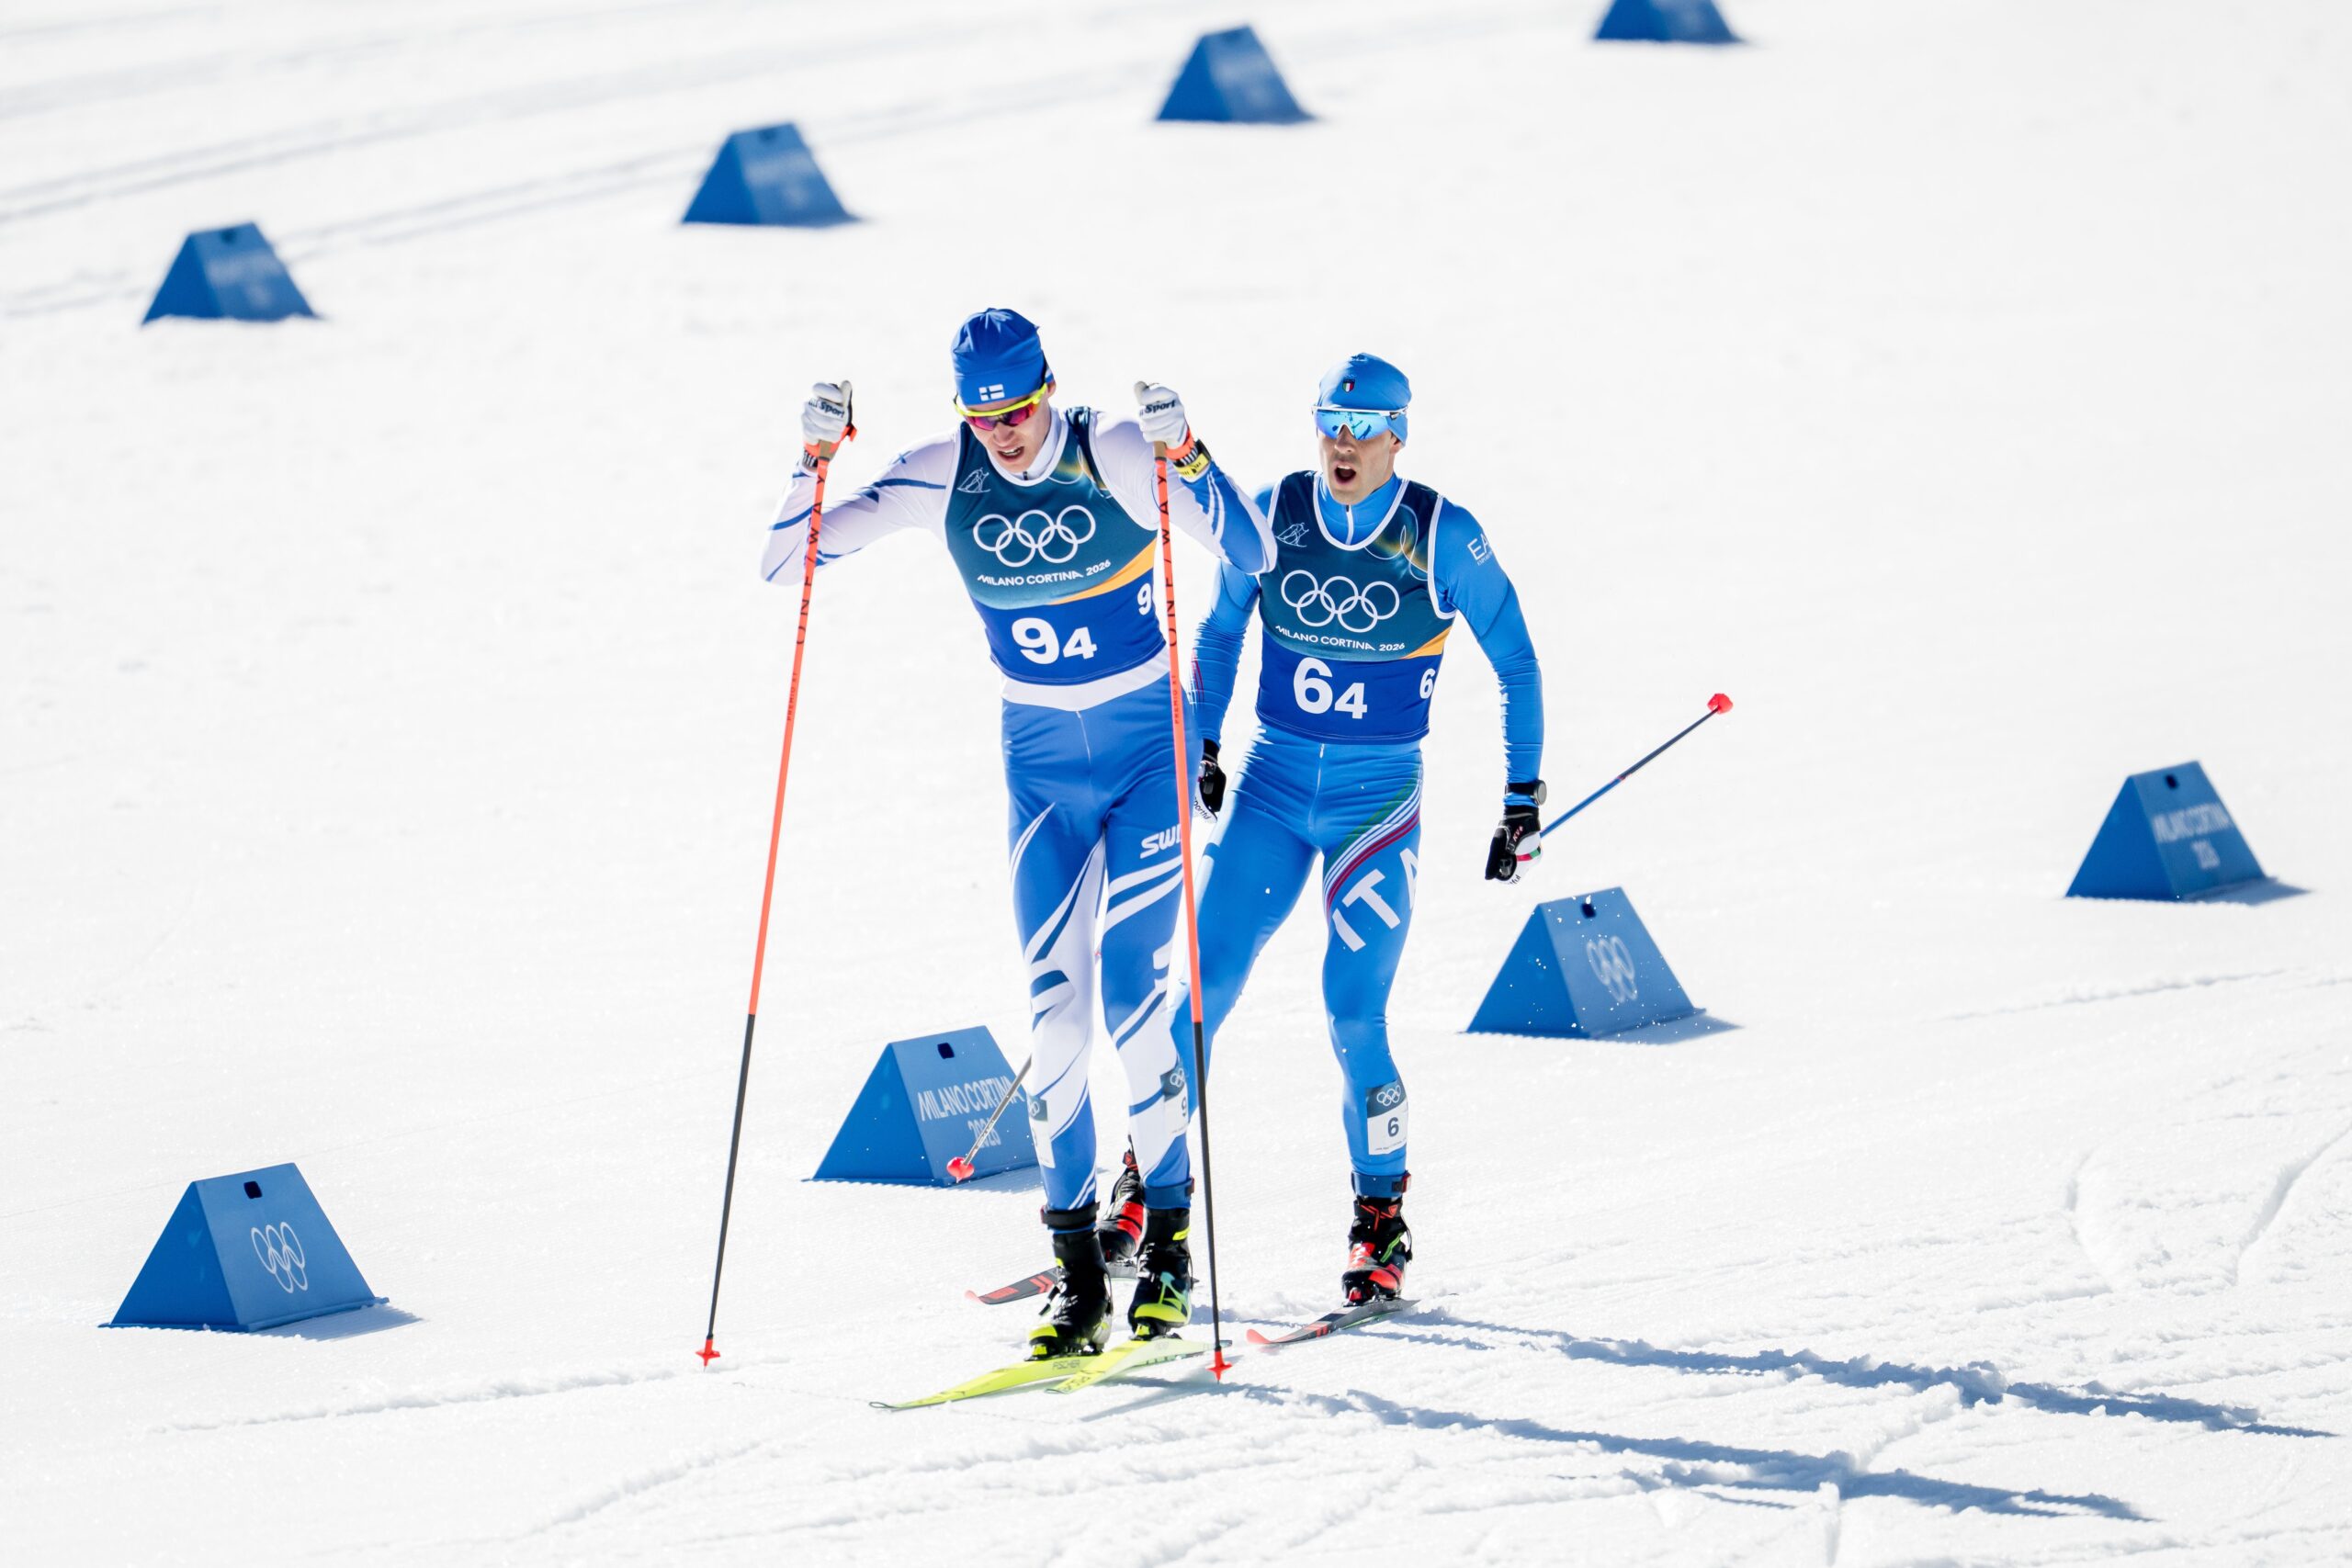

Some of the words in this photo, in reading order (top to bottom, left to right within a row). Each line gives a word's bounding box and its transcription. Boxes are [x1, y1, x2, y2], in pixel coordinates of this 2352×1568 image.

[1467, 533, 1489, 560] EA
[977, 574, 1023, 586] MILANO
[1026, 570, 1084, 585] CORTINA
[1086, 559, 1112, 576] 2026
[1275, 625, 1318, 643] MILANO
[1320, 636, 1376, 651] CORTINA
[1379, 643, 1406, 652] 2026
[1140, 823, 1181, 859] SWI
[918, 1085, 971, 1122] MILANO
[1387, 1116, 1399, 1137] 6
